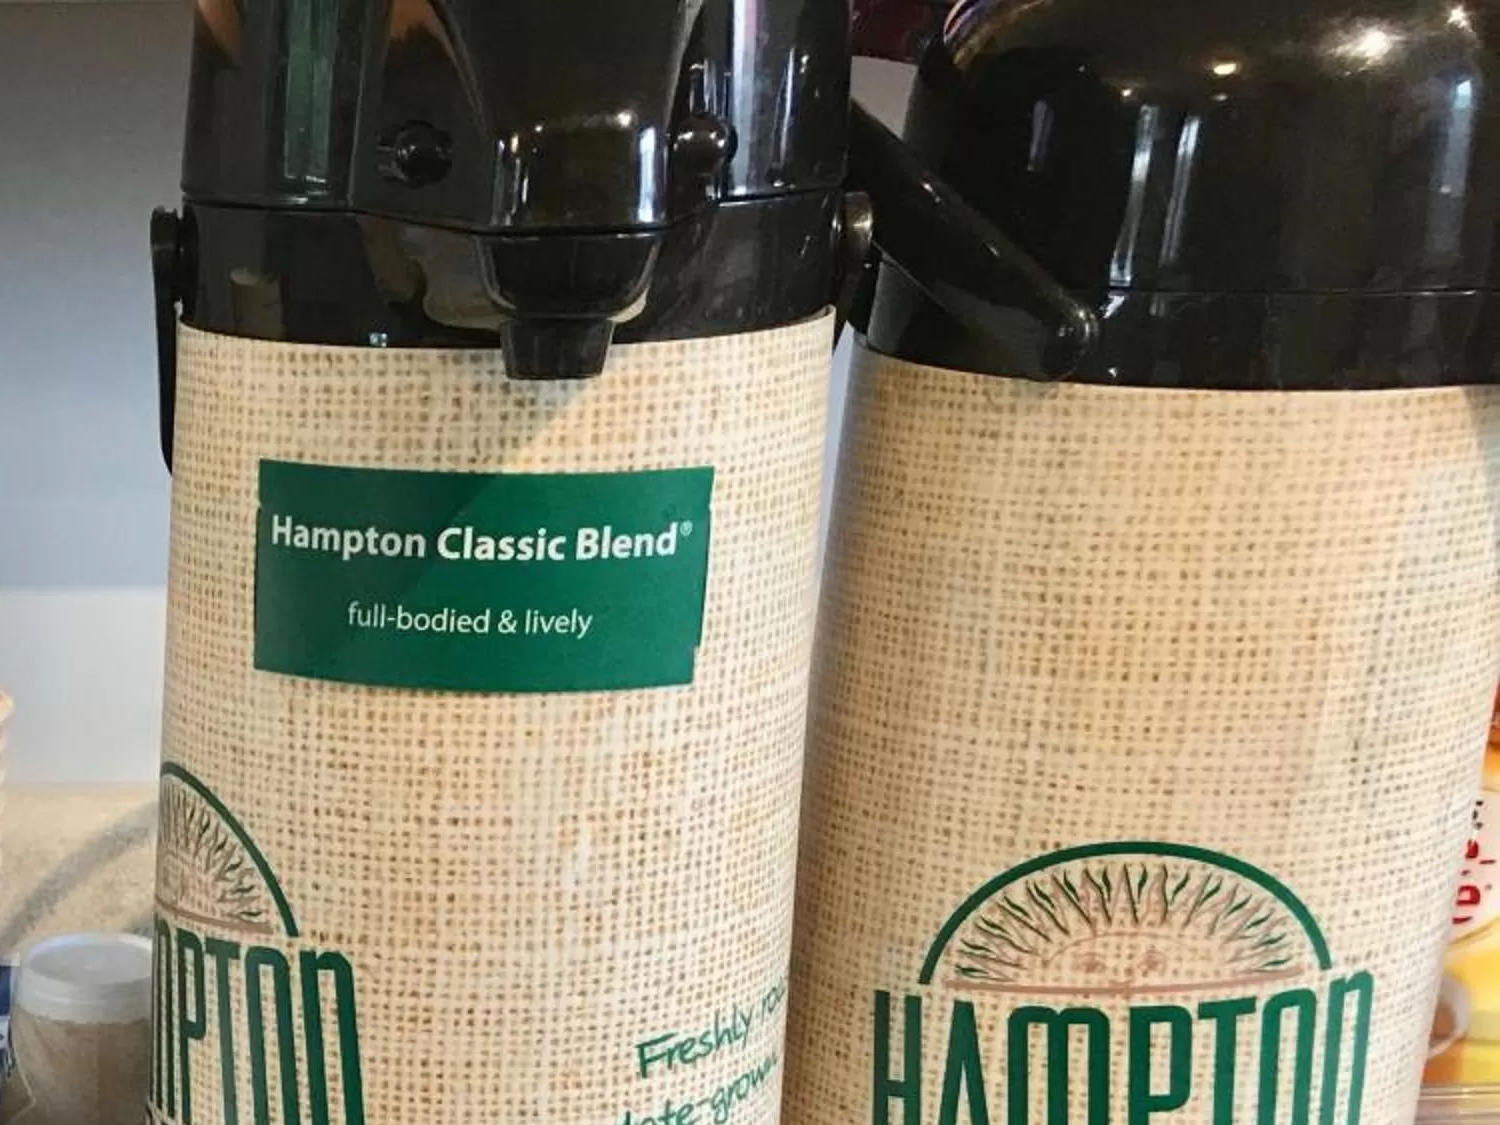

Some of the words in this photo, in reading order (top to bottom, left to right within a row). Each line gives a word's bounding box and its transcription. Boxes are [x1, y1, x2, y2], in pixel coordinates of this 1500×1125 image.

[270, 513, 426, 560] Hampton
[437, 525, 566, 561] Classic
[348, 600, 490, 635] full-bodied
[497, 609, 519, 634] &
[524, 605, 593, 640] lively
[634, 1002, 754, 1079] Freshly
